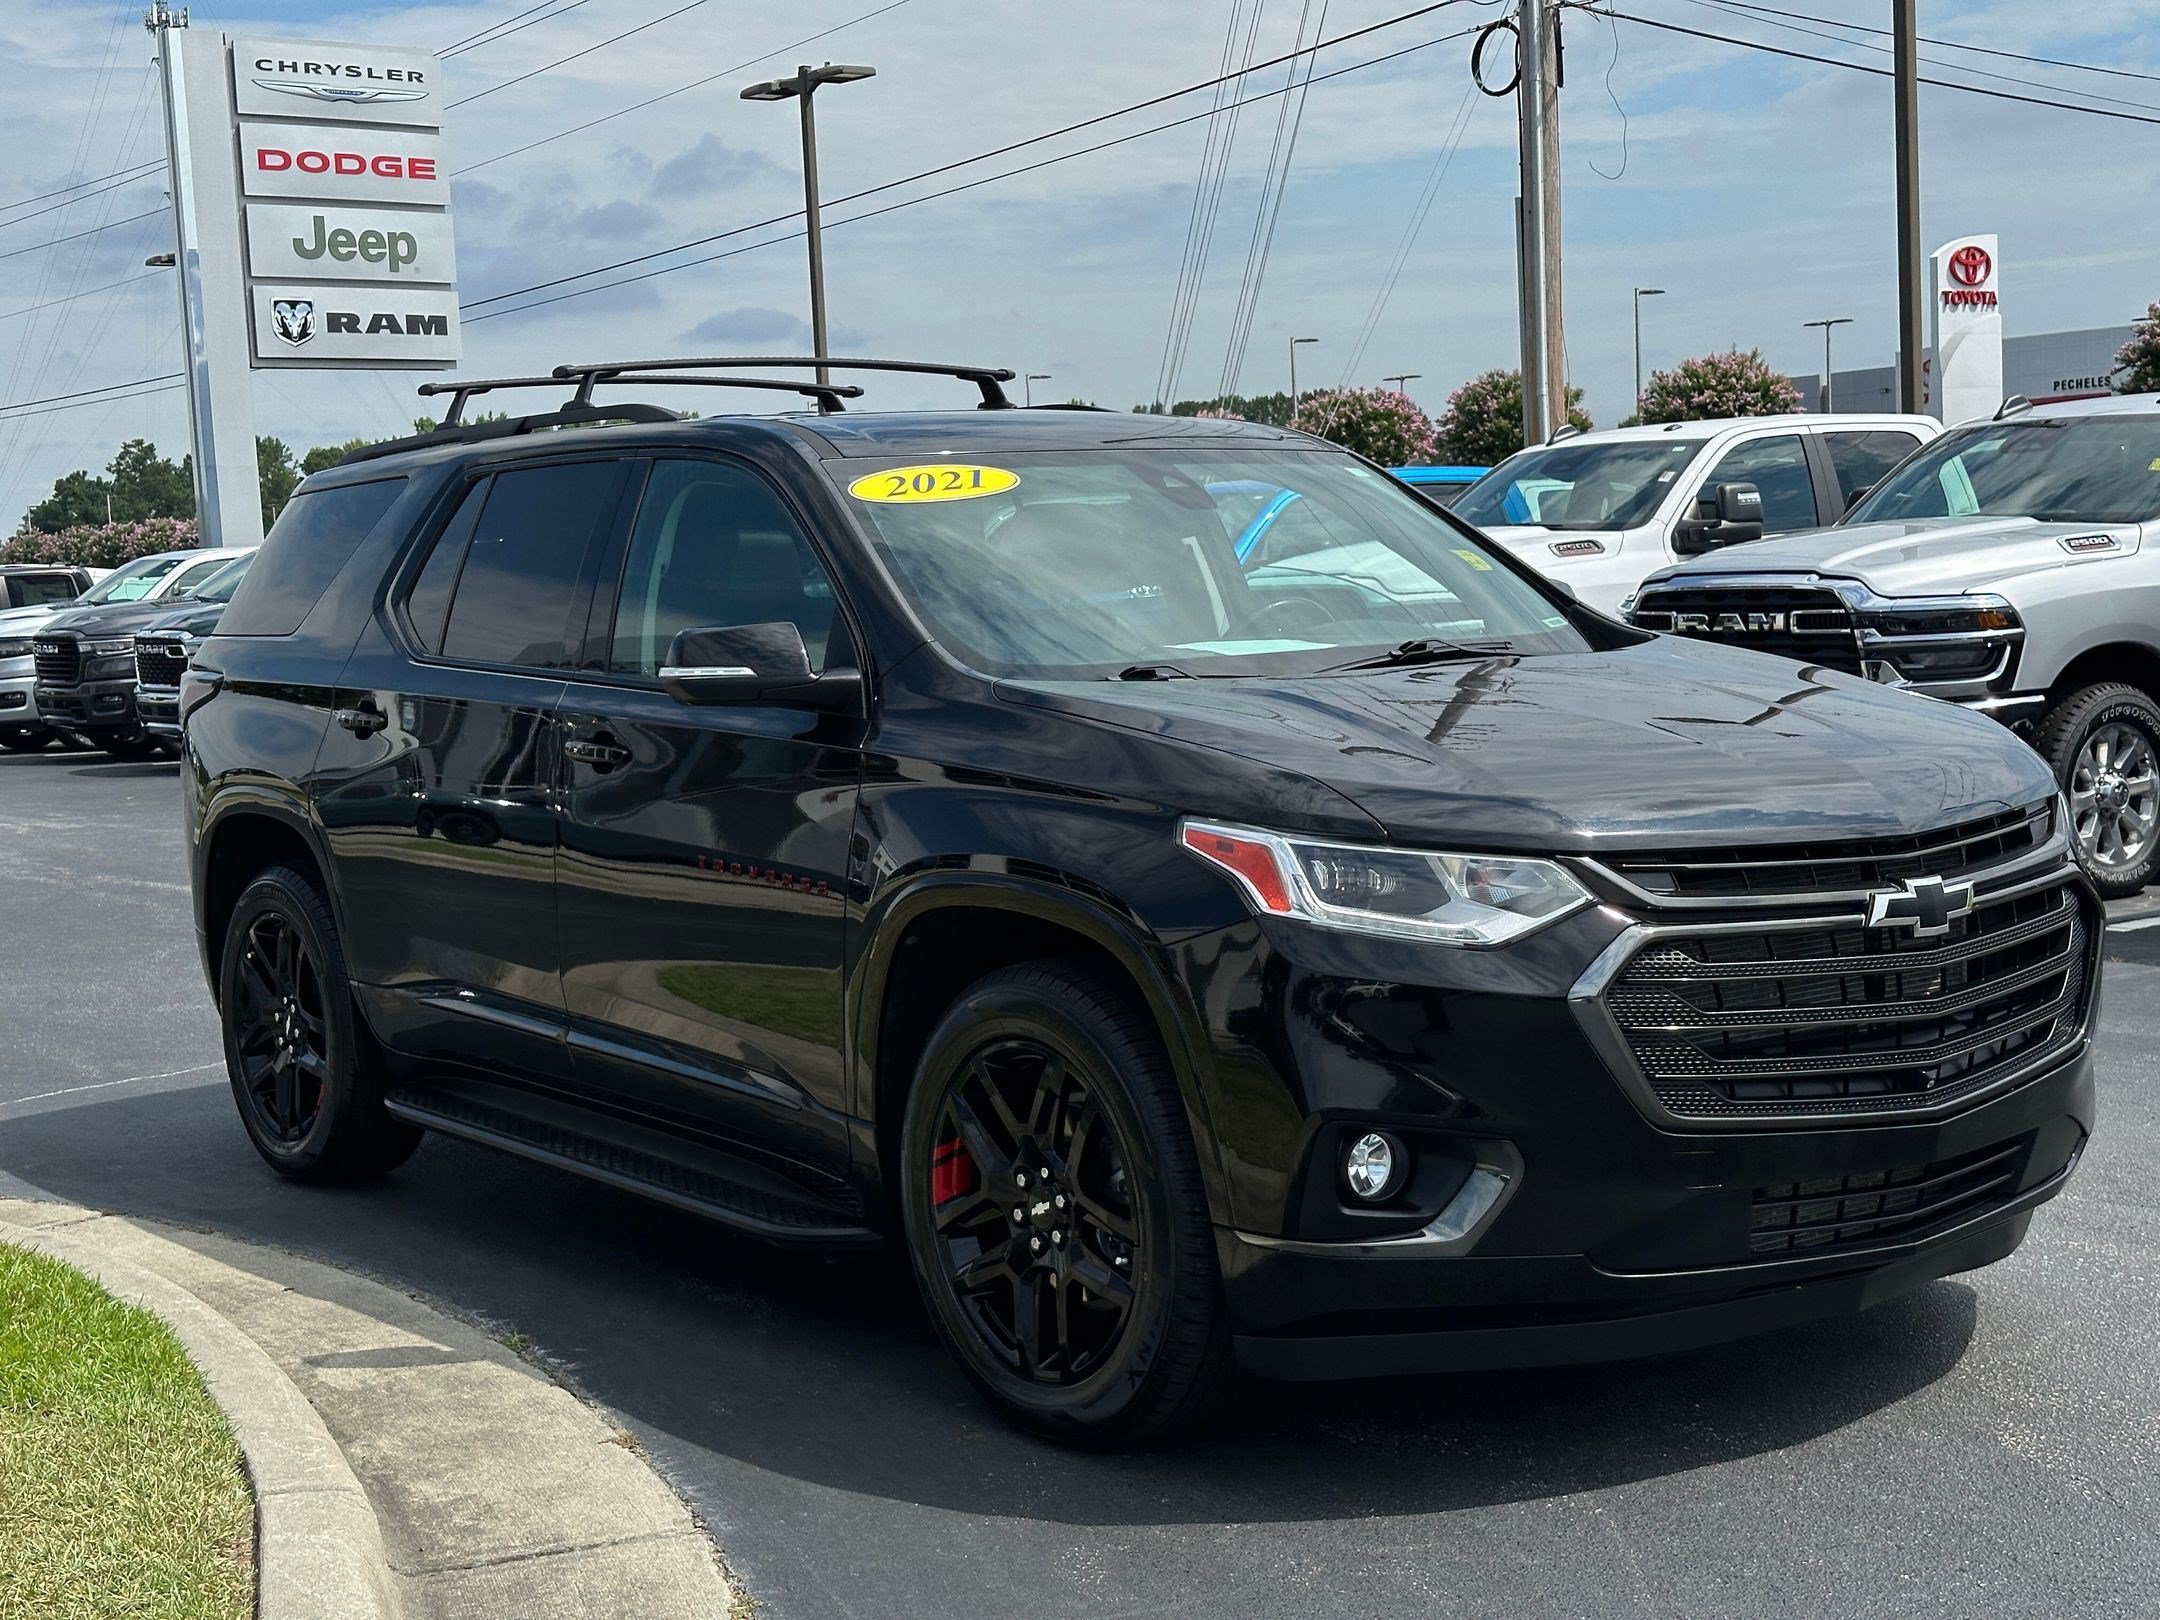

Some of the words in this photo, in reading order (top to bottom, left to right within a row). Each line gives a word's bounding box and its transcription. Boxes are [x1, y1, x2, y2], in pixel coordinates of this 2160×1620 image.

[255, 59, 425, 83] CHRYSLER
[257, 149, 436, 180] DODGE
[293, 216, 417, 272] Jeep
[1942, 291, 1998, 306] TOYOTA
[326, 313, 449, 336] RAM
[2053, 375, 2111, 391] PECHELES
[886, 469, 983, 497] 2021
[2069, 536, 2109, 547] 2500
[1677, 613, 1787, 632] RAM
[35, 644, 59, 654] RAM
[137, 644, 164, 654] RAM
